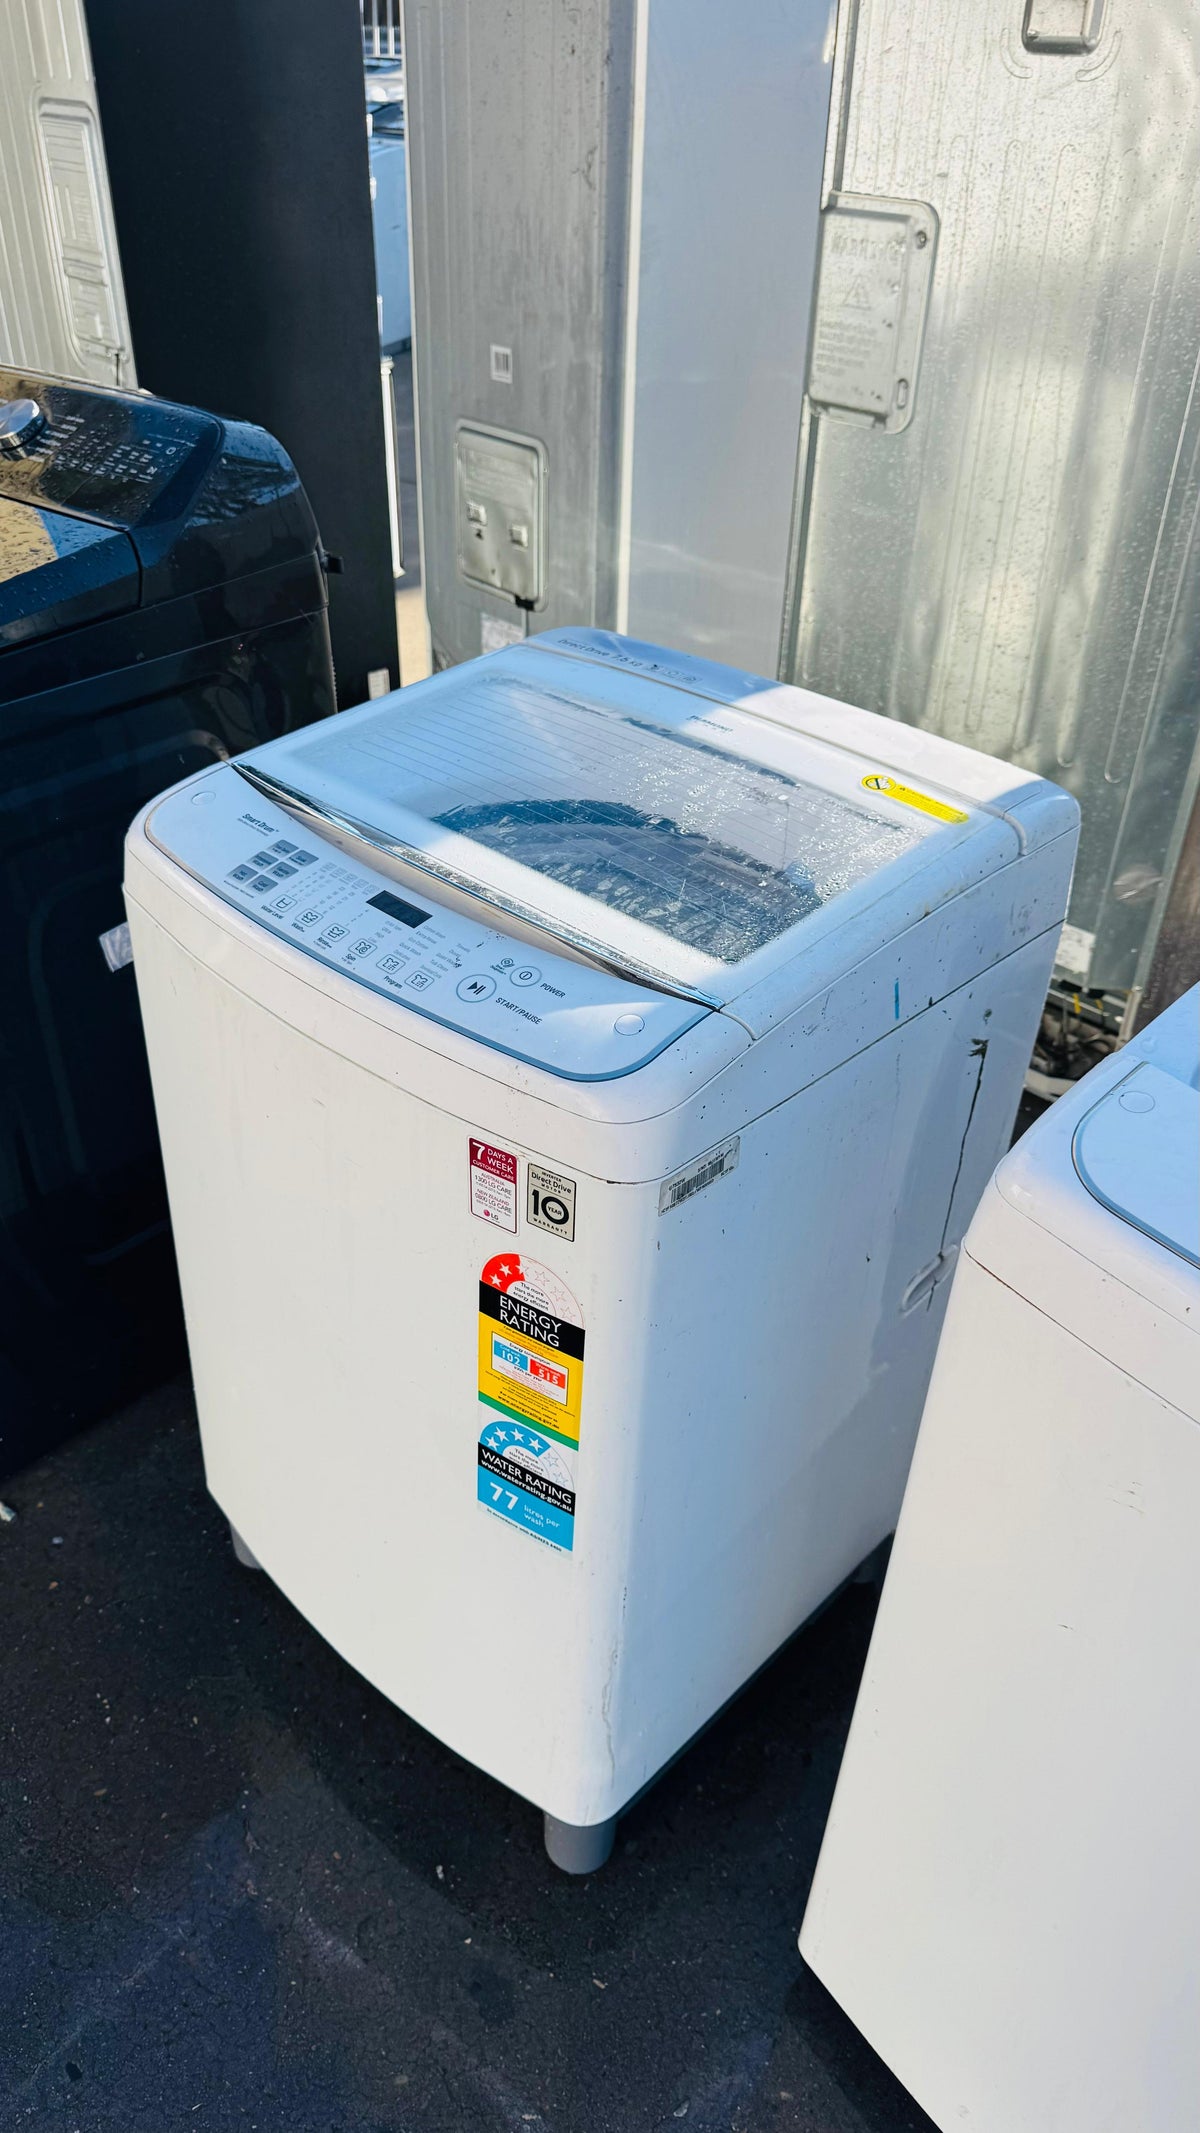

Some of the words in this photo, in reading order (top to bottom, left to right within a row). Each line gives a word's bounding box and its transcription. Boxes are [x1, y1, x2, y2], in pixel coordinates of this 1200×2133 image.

[242, 814, 260, 826] Smart
[384, 976, 403, 989] Program
[540, 983, 566, 998] POWER
[496, 997, 543, 1025] START/PAUSE
[472, 1142, 486, 1160] 7
[488, 1148, 506, 1162] DAYS
[473, 1159, 500, 1175] CUSTOMER
[501, 1171, 515, 1182] CARE
[487, 1157, 514, 1175] WEEK
[475, 1175, 487, 1186] 1300
[488, 1180, 496, 1189] LG
[497, 1184, 512, 1196] CARE
[481, 1173, 505, 1186] AUSTRALIA
[532, 1172, 552, 1186] Direct
[553, 1181, 572, 1194] Drive
[542, 1172, 562, 1183] INVERTER
[541, 1184, 562, 1194] MOTOR
[475, 1193, 488, 1204] 0800
[488, 1199, 496, 1207] LG
[497, 1203, 512, 1214] CARE
[532, 1189, 570, 1226] 10
[548, 1206, 562, 1216] YEAR
[491, 1212, 499, 1221] LG
[533, 1218, 568, 1235] WARRANTY
[513, 1292, 529, 1302] energy
[514, 1286, 526, 1295] stars
[535, 1296, 549, 1306] more
[530, 1287, 544, 1297] more
[500, 1295, 562, 1333] ENERGY
[500, 1309, 560, 1348] RATING
[510, 1343, 524, 1353] Energy
[502, 1350, 521, 1366] 102
[538, 1369, 559, 1385] 515
[498, 1396, 560, 1429] www.energyrating.gov.au
[509, 1451, 521, 1460] stars
[530, 1462, 544, 1472] more
[515, 1448, 524, 1456] The
[525, 1454, 539, 1464] more
[481, 1449, 523, 1480] WATER
[526, 1474, 572, 1505] RATING
[481, 1460, 572, 1513] www.waterrating.gov.au
[490, 1481, 519, 1511] 77
[524, 1504, 544, 1520] litres
[546, 1518, 561, 1528] per
[524, 1513, 545, 1528] wash
